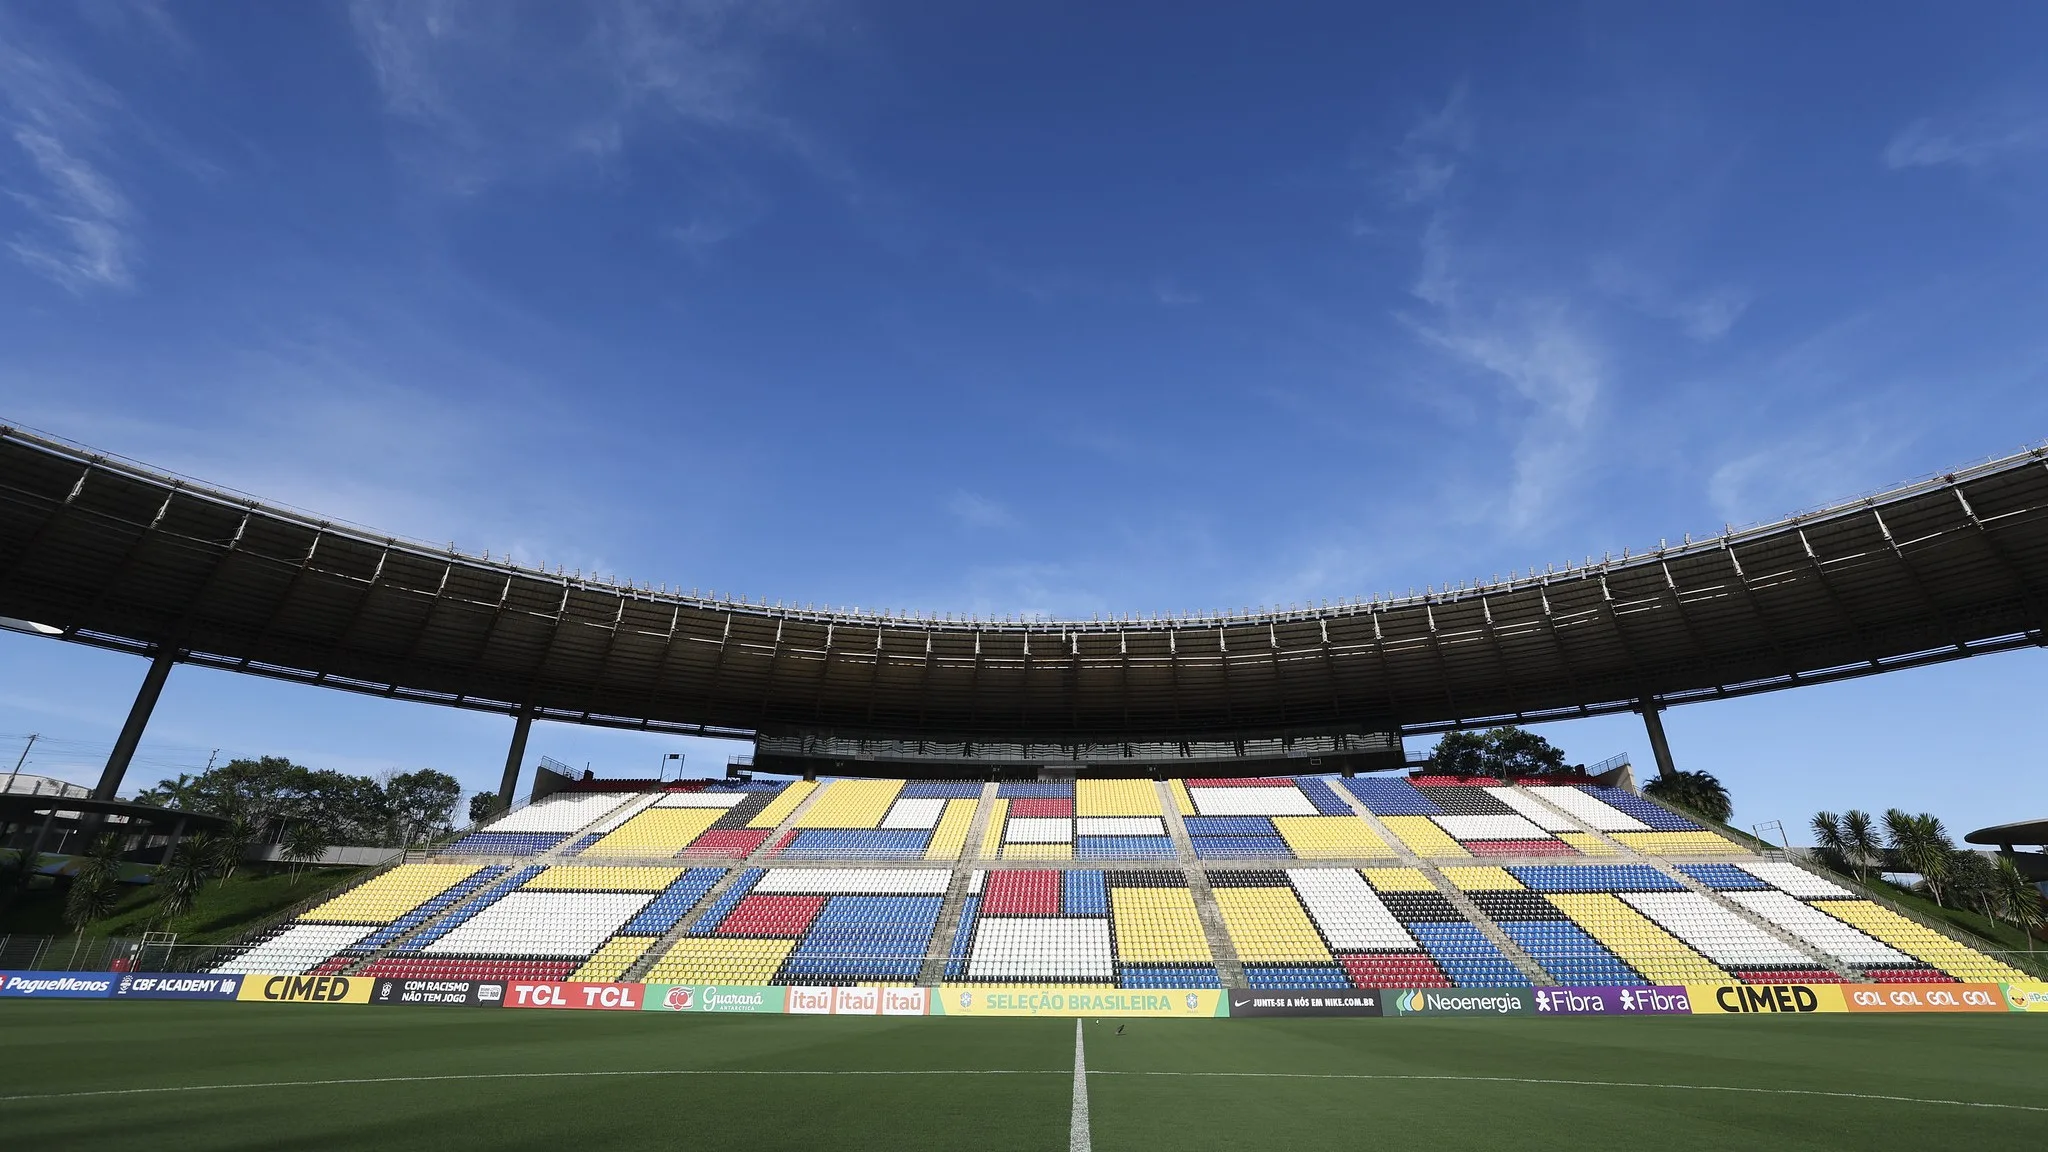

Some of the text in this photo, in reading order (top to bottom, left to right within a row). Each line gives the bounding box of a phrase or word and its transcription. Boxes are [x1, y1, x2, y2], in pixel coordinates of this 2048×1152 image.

[132, 979, 218, 992] CBF ACADEMY
[264, 976, 350, 1001] CIMED
[404, 981, 426, 991] COM
[427, 982, 470, 992] RACISMO
[515, 985, 567, 1006] TCL
[583, 986, 636, 1007] TCL
[402, 992, 466, 1003] NÃO TEM JOGO
[702, 986, 764, 1011] Guaraná
[792, 990, 922, 1011] itaú itaú itaú
[986, 991, 1171, 1014] SELEÇÃO BRASILEIRA
[1252, 996, 1375, 1008] JUNTE-SE A NÓS EM NIKE.COM.BR
[1427, 992, 1521, 1013] Neoenergia
[1551, 990, 1690, 1012] Fibra Fibra
[1716, 986, 1818, 1012] CIMED
[1853, 991, 1997, 1006] GOL GOL GOL GOL
